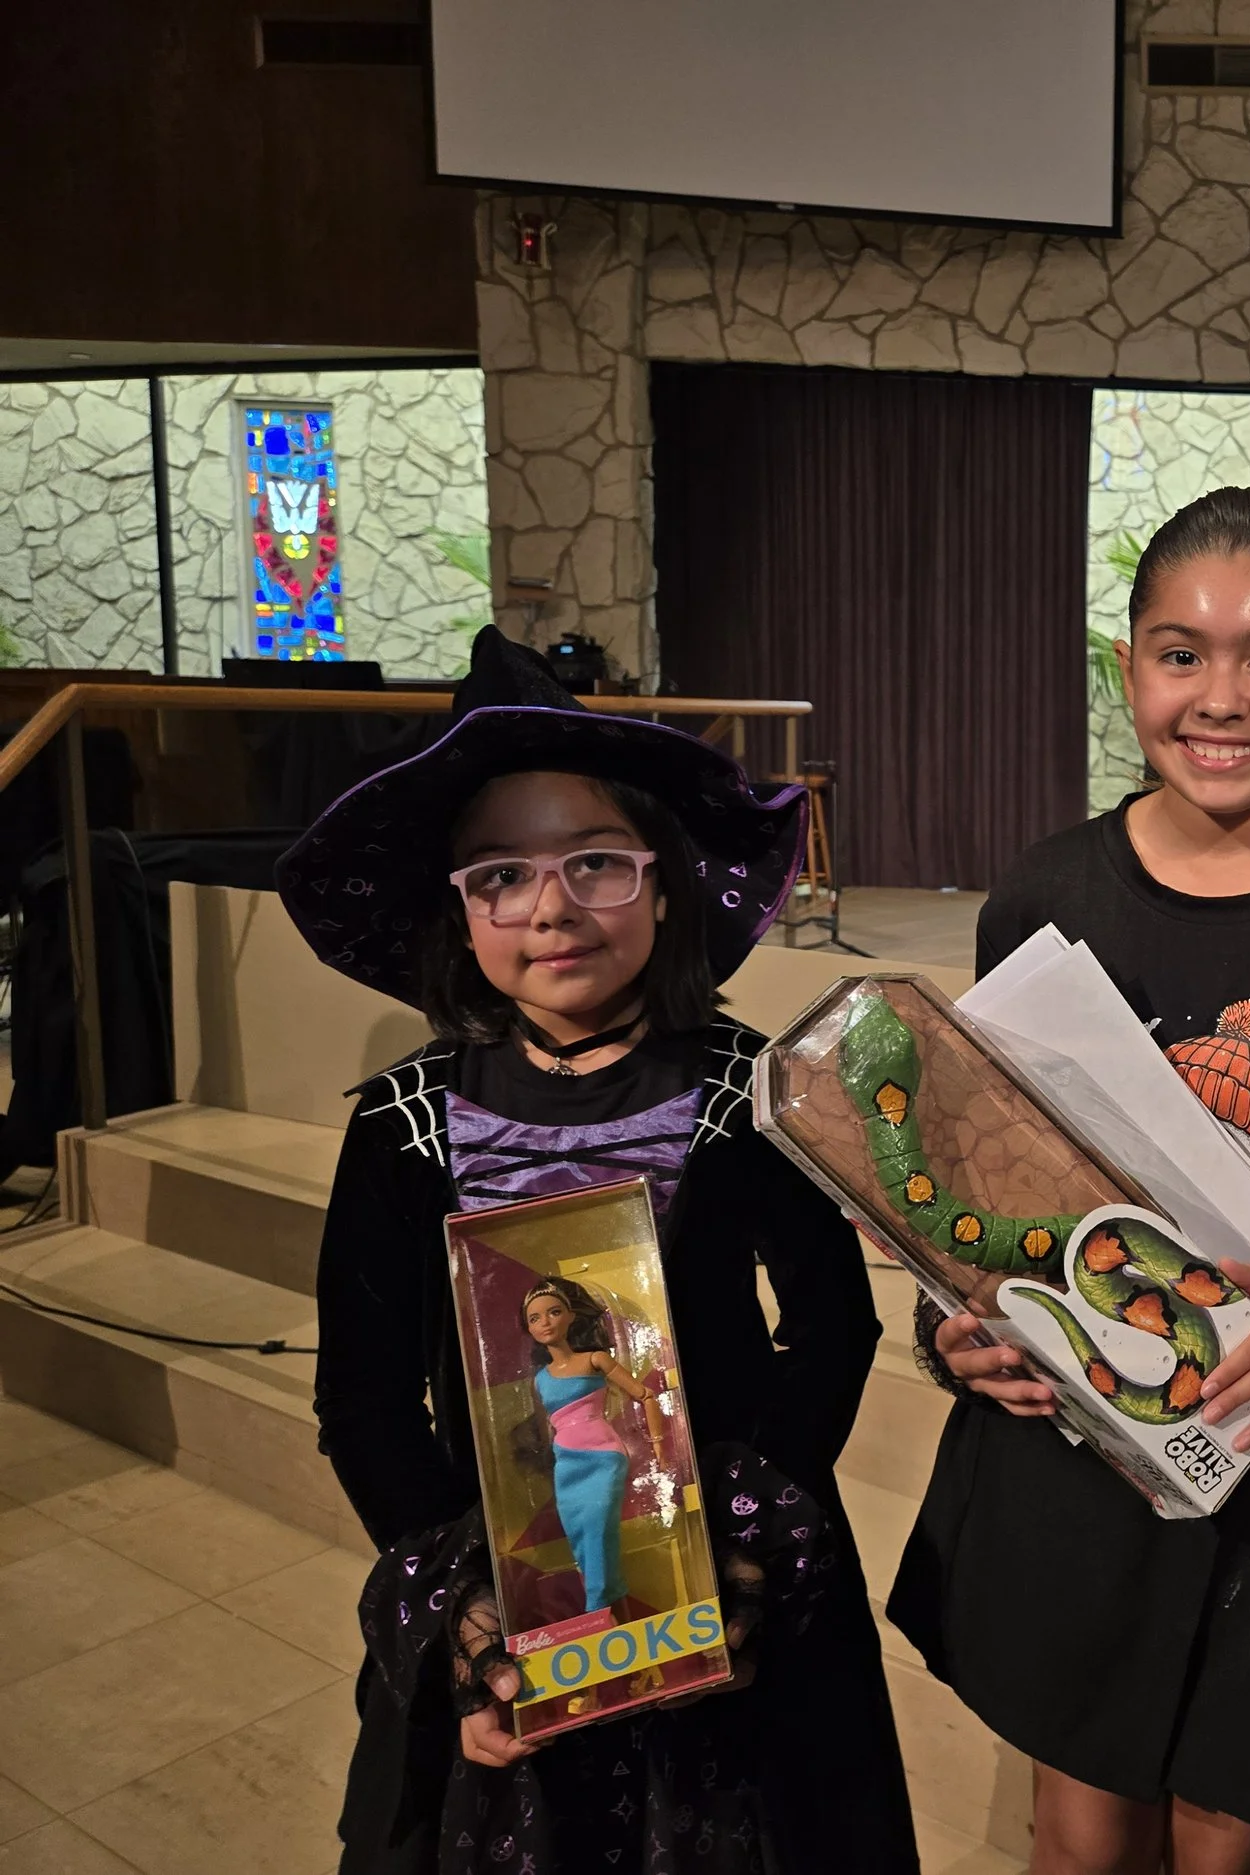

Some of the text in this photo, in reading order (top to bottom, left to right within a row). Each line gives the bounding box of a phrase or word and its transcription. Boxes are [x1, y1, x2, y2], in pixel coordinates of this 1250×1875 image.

[1166, 1439, 1222, 1493] ROBO
[1180, 1425, 1235, 1476] ALIVE
[515, 1631, 555, 1656] Barbie
